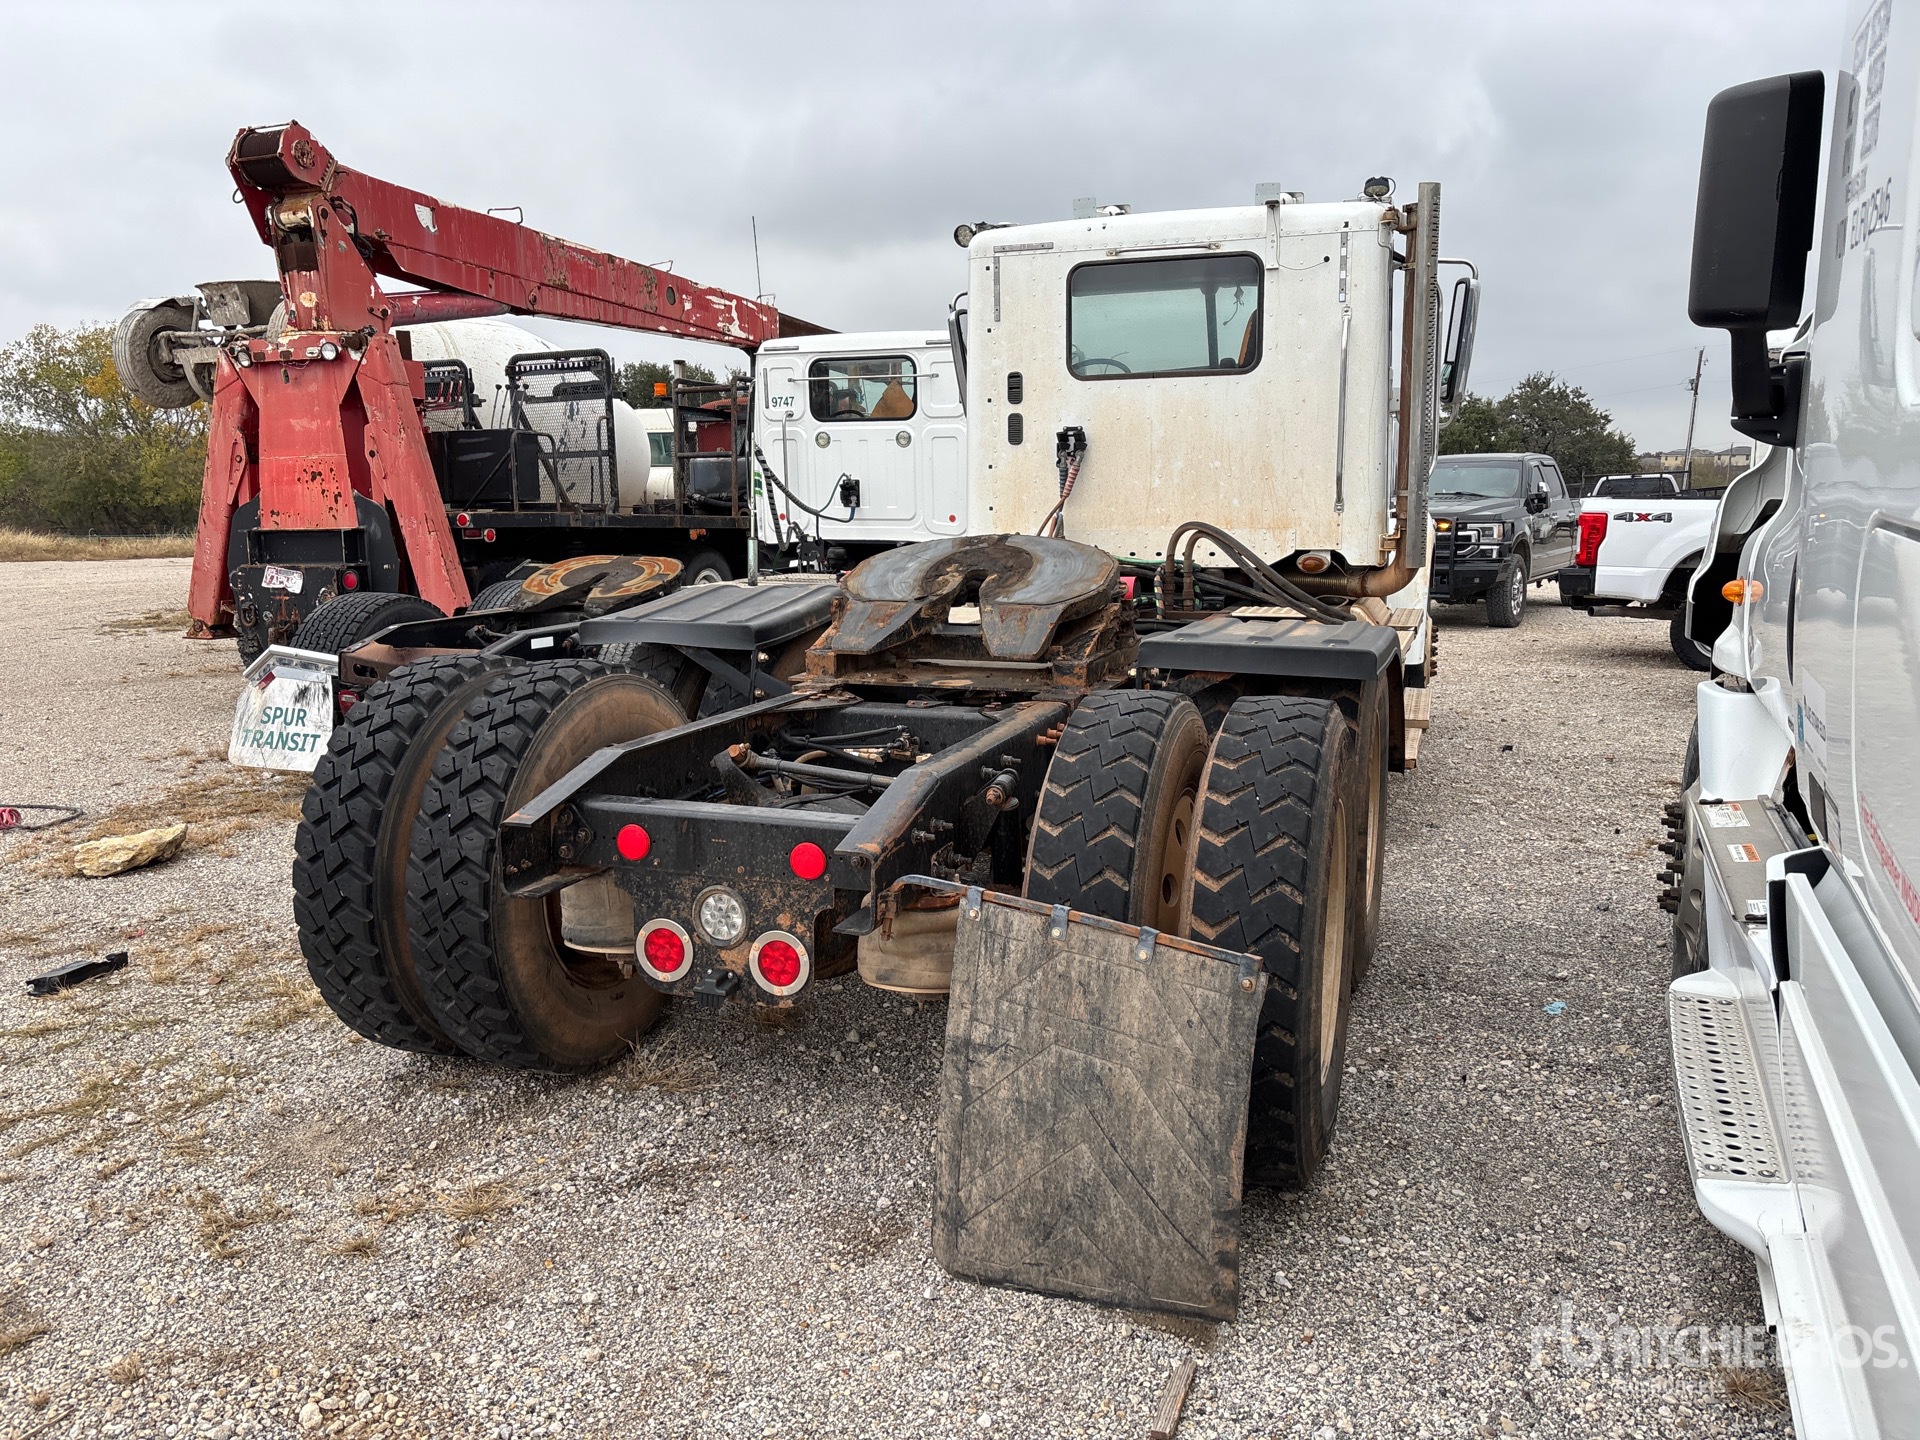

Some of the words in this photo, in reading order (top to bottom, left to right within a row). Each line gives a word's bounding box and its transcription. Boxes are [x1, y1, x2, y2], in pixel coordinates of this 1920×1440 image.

[771, 396, 795, 408] 9747
[260, 705, 308, 727] SPUR
[242, 728, 321, 753] TRANSIT
